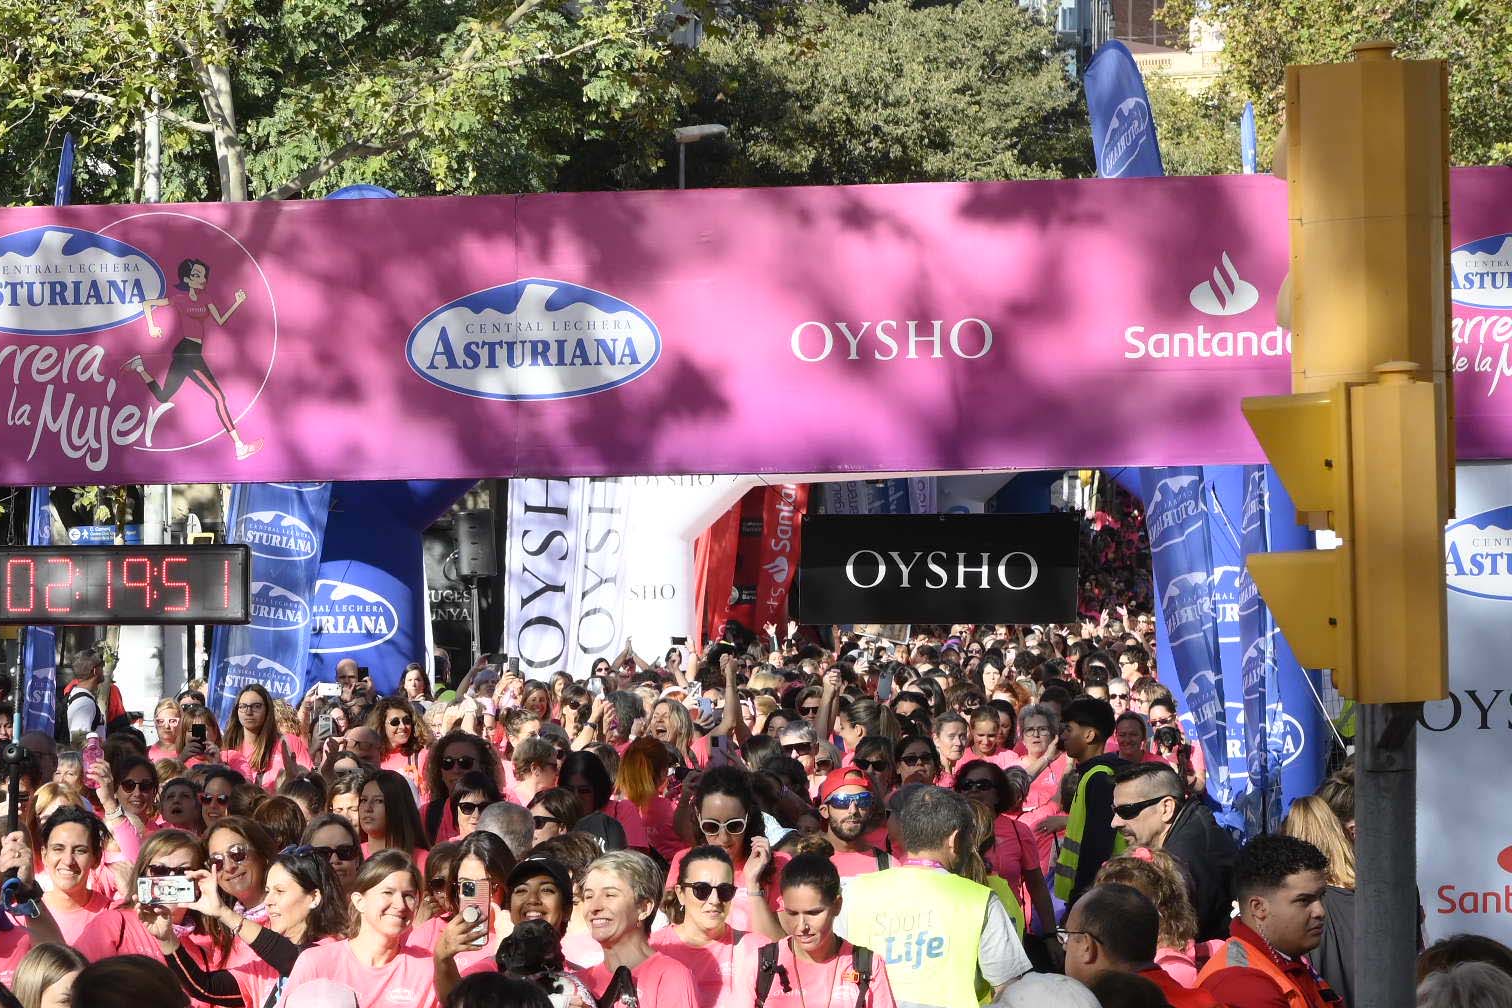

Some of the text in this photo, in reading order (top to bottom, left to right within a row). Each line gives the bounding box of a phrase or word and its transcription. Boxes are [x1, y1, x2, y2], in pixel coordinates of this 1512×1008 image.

[69, 262, 141, 273] LECHERA
[465, 318, 633, 334] CENTRAL LECHERA
[790, 317, 994, 362] OYSHO
[1452, 314, 1512, 345] arre
[426, 326, 641, 371] ASTURIANA
[1474, 344, 1493, 372] la
[6, 388, 32, 427] la
[27, 378, 175, 472] Mujer
[772, 484, 796, 552] Santa
[517, 478, 570, 669] OYSH
[577, 478, 622, 655] OYSH
[845, 549, 1038, 590] OYSHO
[630, 584, 676, 601] SHO
[250, 604, 304, 622] URIANA
[335, 604, 384, 613] LECHERA
[431, 608, 472, 621] UNYA
[311, 615, 389, 634] URIANA
[885, 930, 944, 969] Life
